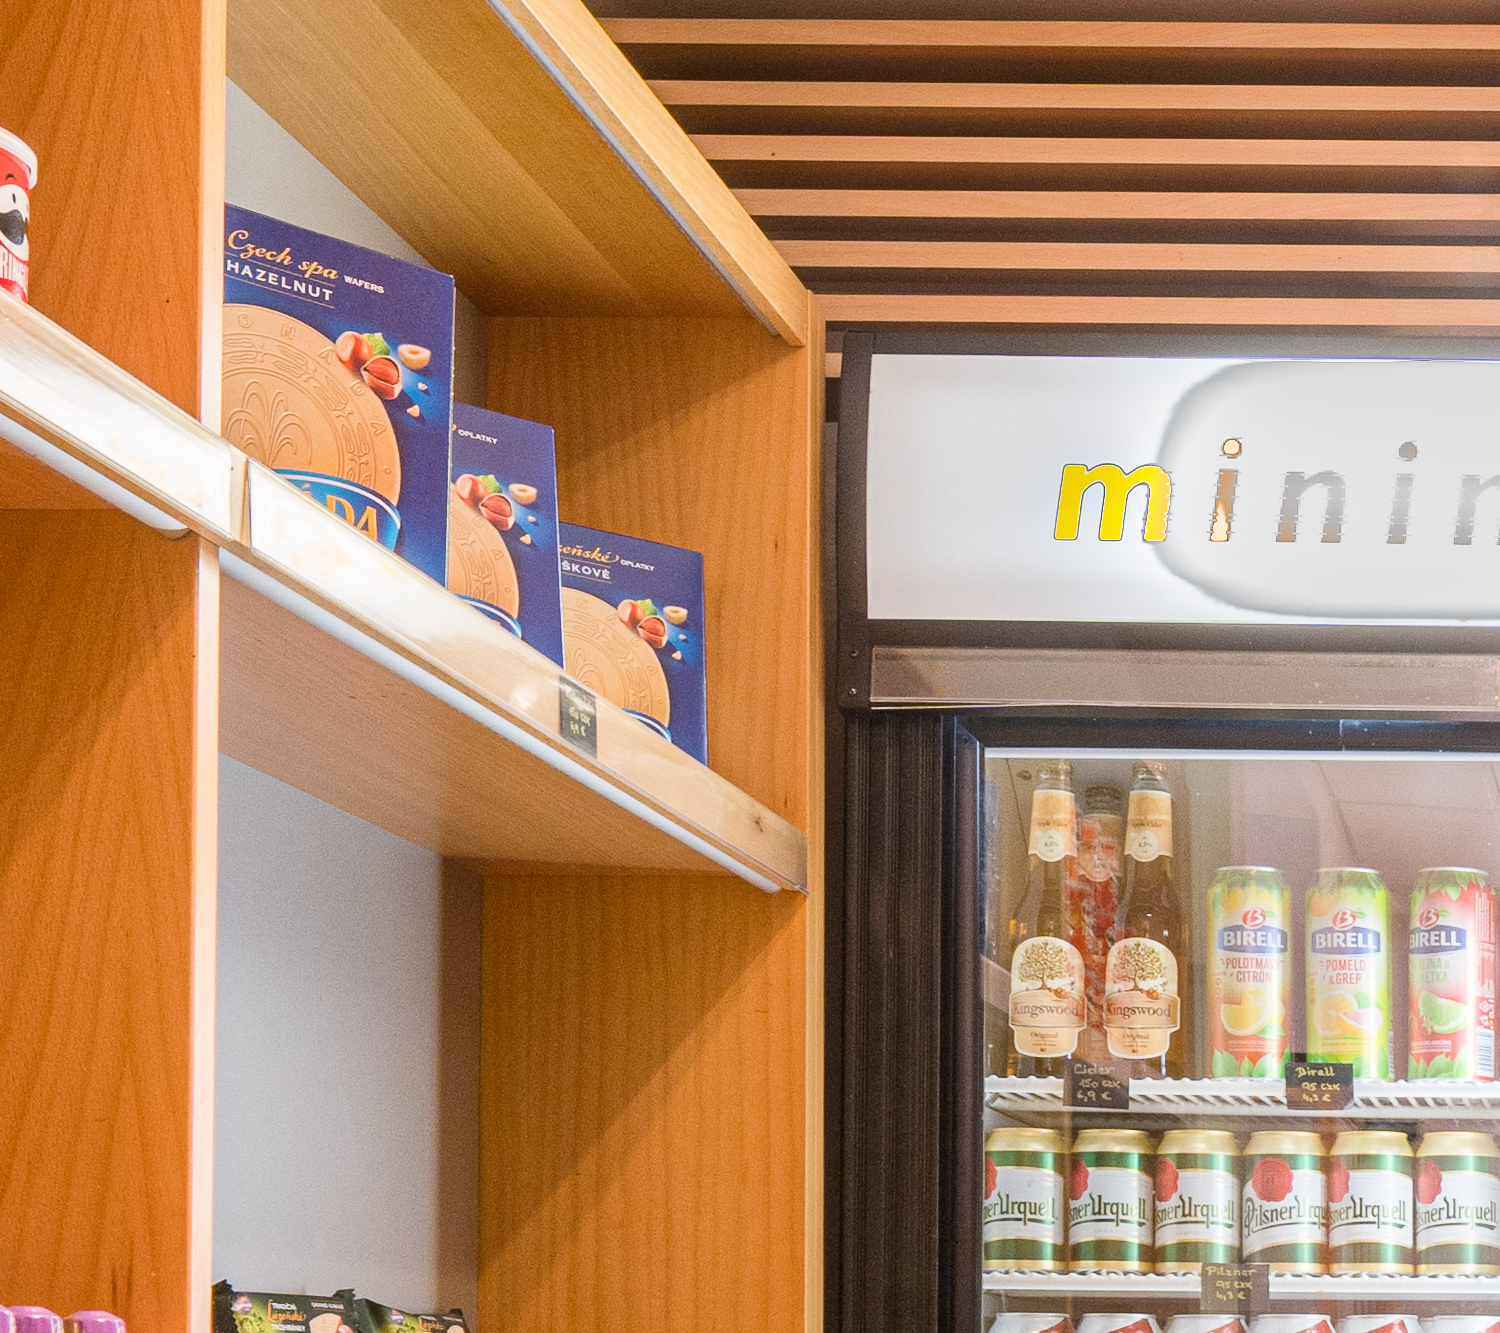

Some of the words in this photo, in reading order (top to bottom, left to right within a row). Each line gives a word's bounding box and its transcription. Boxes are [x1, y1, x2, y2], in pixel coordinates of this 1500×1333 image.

[227, 229, 293, 267] Czech
[297, 254, 339, 281] spa
[344, 275, 385, 295] WAFERS
[225, 259, 334, 303] HAZELNUT
[1223, 931, 1284, 949] BIRELL
[1315, 931, 1376, 949] BIRELL
[1325, 959, 1366, 972] POMELO
[1014, 1003, 1079, 1020] Kingswood
[1106, 1003, 1171, 1020] Kingswood
[1074, 1063, 1116, 1075] Cider
